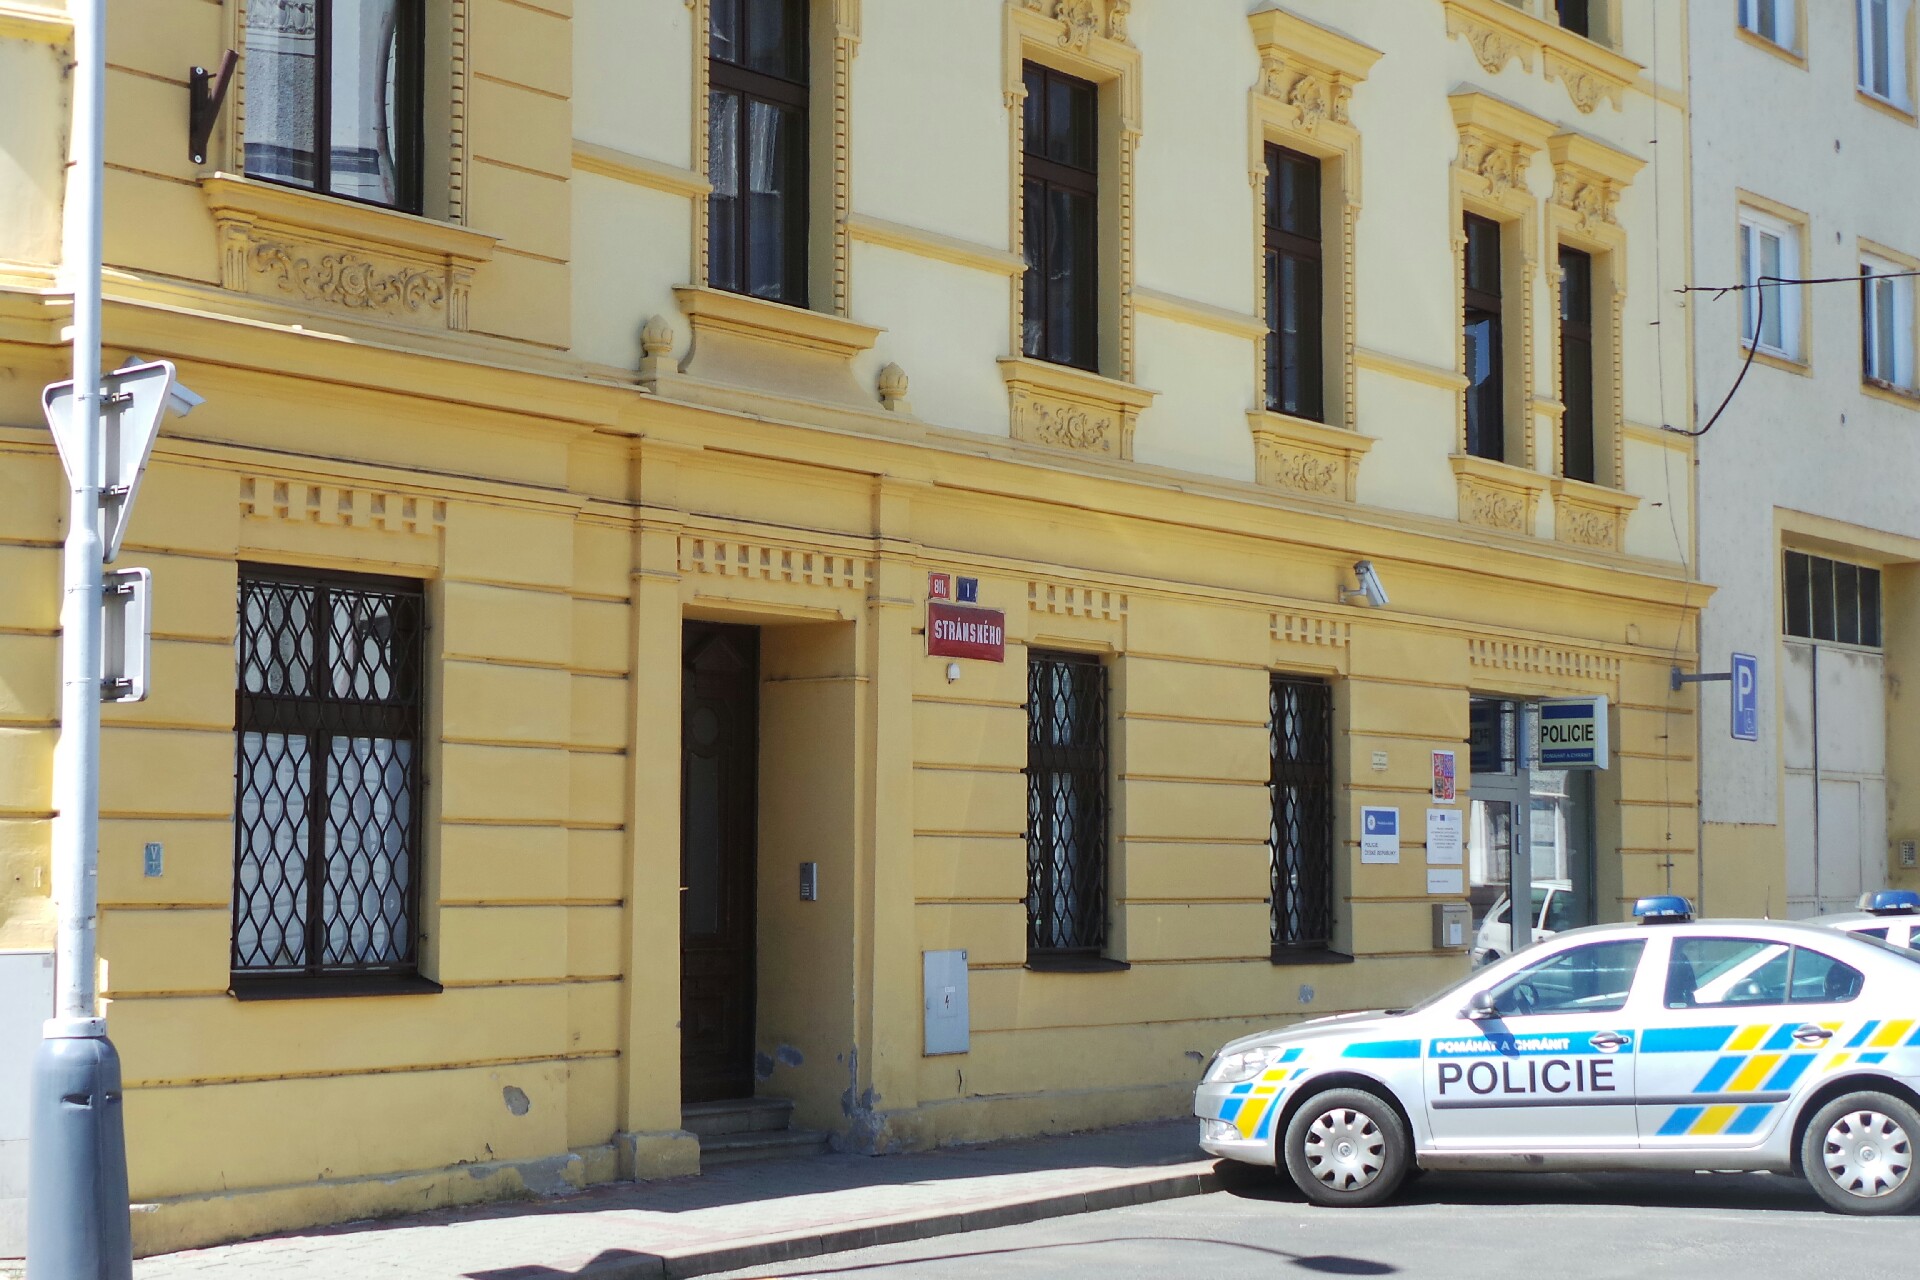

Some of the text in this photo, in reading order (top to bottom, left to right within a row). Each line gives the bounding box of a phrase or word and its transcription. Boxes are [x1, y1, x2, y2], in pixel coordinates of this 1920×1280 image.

[935, 617, 1001, 645] STRÁNSKÉHO
[1738, 665, 1752, 712] P
[1541, 724, 1594, 743] POLICIE
[1436, 1037, 1570, 1053] POMÁHAT A CHRÁNIT
[1438, 1059, 1616, 1095] POLICIE
